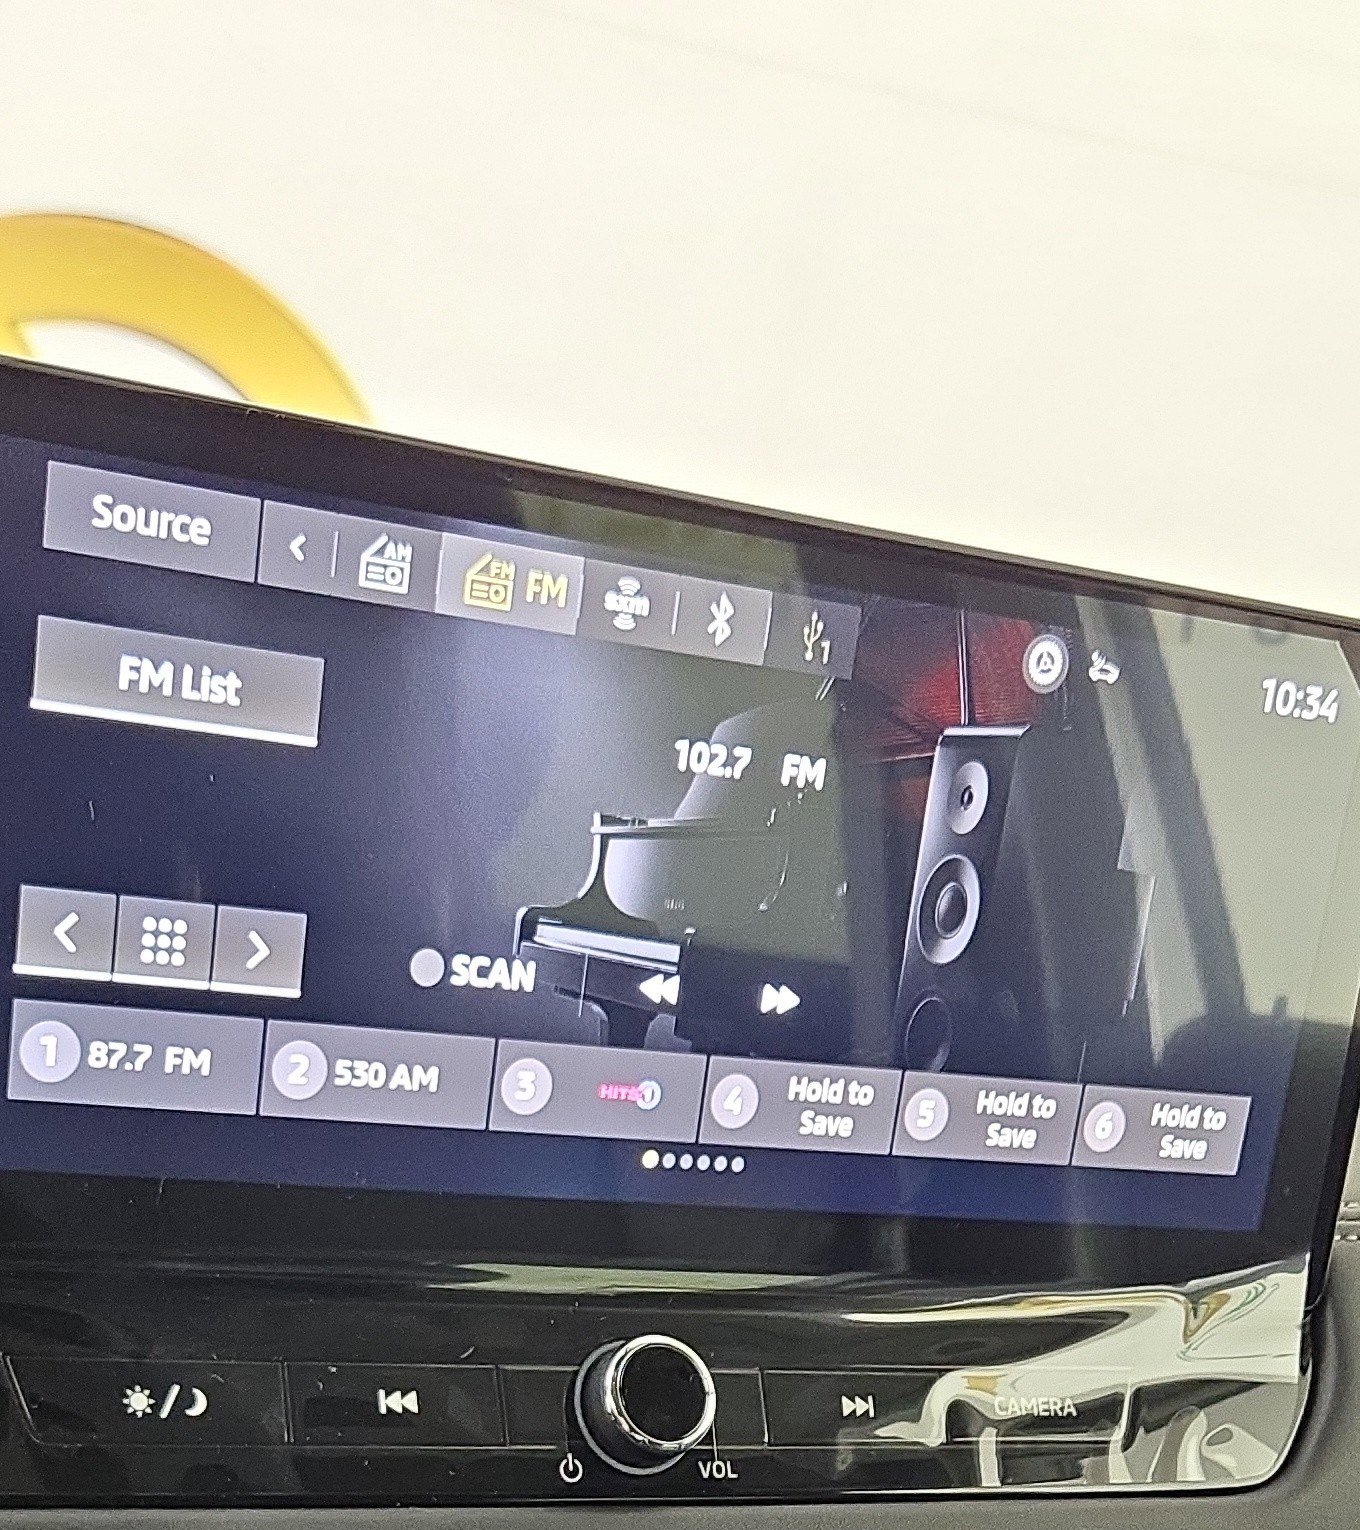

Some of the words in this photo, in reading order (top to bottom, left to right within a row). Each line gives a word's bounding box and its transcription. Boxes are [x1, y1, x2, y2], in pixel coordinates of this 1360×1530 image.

[91, 494, 212, 547] Source
[383, 540, 413, 562] AM
[526, 569, 569, 608] FM
[118, 655, 175, 698] FM
[181, 662, 243, 708] List
[1261, 677, 1340, 723] 10:34
[673, 738, 752, 779] 102.7
[781, 753, 827, 790] FM
[451, 952, 536, 991] SCAN
[39, 1036, 60, 1068] 1
[88, 1042, 152, 1072] 87.7
[165, 1046, 212, 1077] FM
[287, 1054, 309, 1085] 2
[333, 1058, 384, 1088] 530
[388, 1062, 439, 1093] AM
[513, 1069, 538, 1101] 3
[723, 1086, 743, 1116] 4
[787, 1075, 846, 1105] Hold
[848, 1079, 875, 1107] to
[976, 1089, 1032, 1117] Hold
[1032, 1094, 1057, 1120] to
[799, 1110, 854, 1138] Save
[916, 1100, 936, 1128] 5
[1094, 1111, 1113, 1140] 6
[1150, 1102, 1202, 1130] Hold
[1203, 1106, 1227, 1132] to
[985, 1123, 1038, 1150] Save
[1158, 1135, 1208, 1160] Save
[994, 1396, 1077, 1417] CAMERA
[697, 1459, 739, 1479] VOL
